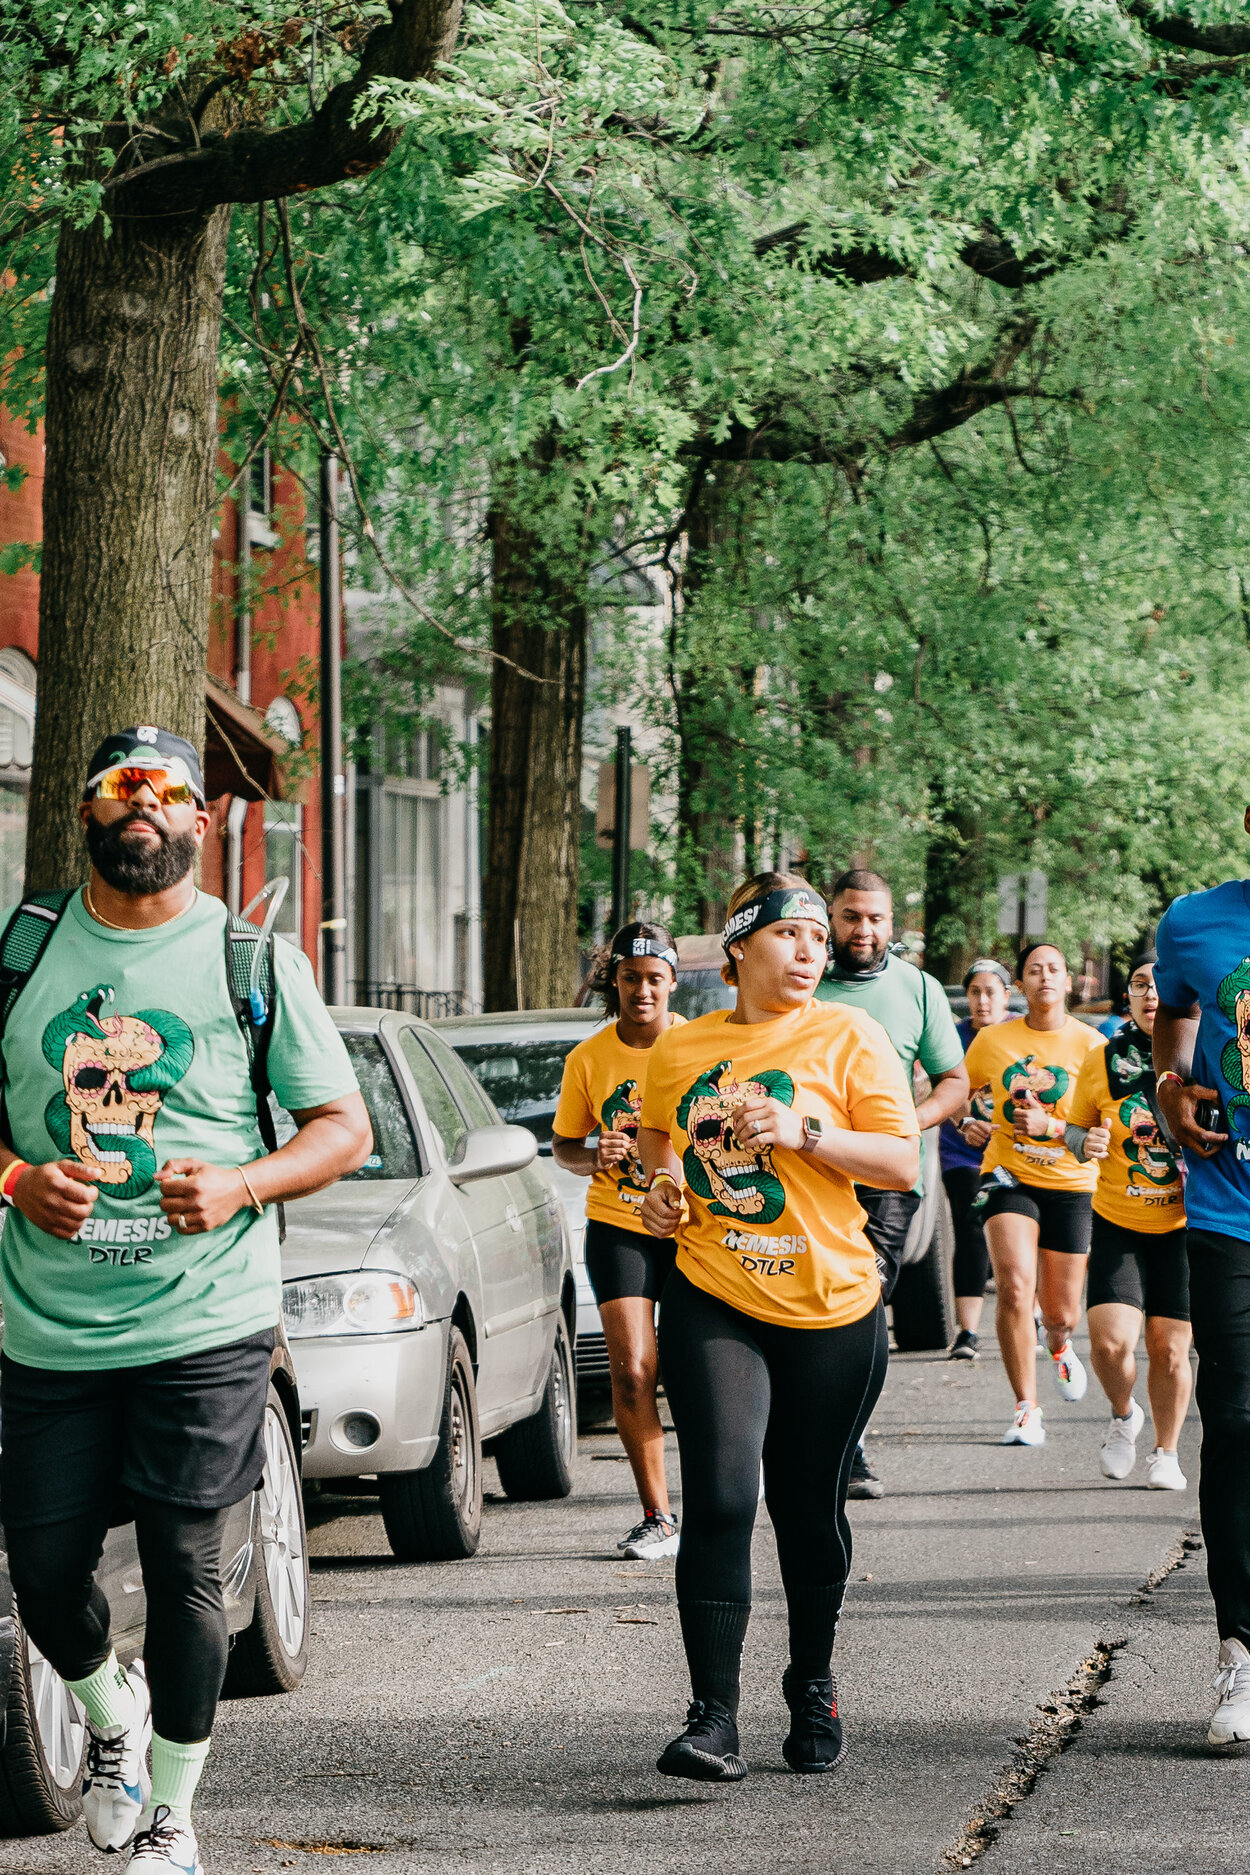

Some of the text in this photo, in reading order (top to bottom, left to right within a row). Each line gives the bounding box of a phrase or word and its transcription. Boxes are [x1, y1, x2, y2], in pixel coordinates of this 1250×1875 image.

[71, 1216, 172, 1243] EMESIS
[721, 1227, 808, 1257] NEMESIS
[87, 1244, 155, 1267] DTLR
[741, 1254, 797, 1277] DTLR
